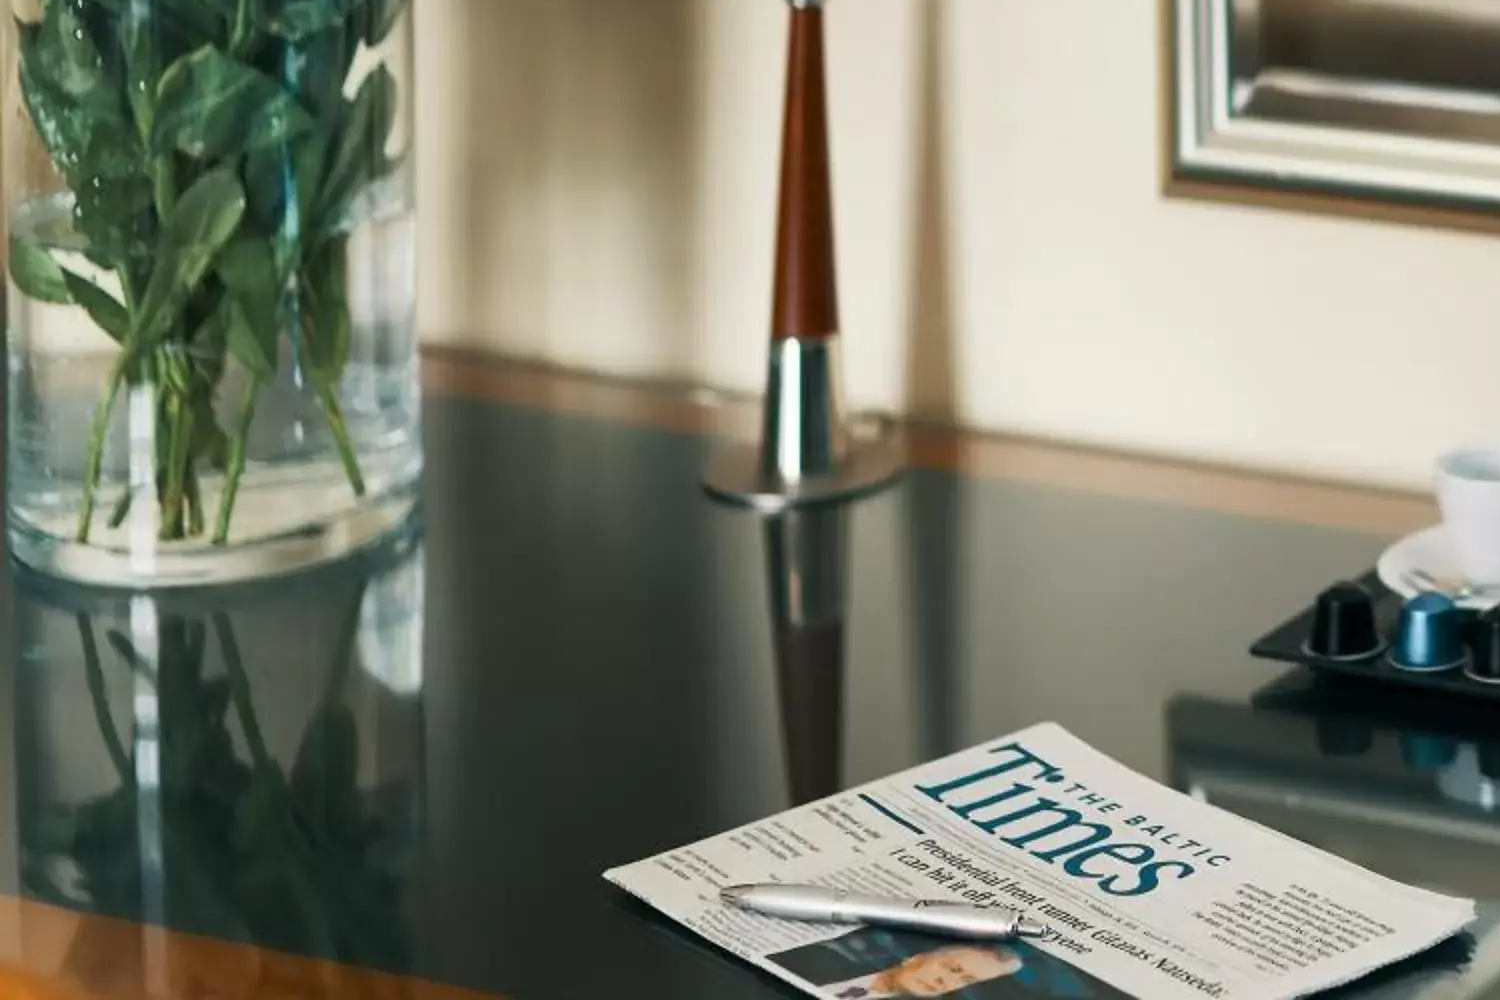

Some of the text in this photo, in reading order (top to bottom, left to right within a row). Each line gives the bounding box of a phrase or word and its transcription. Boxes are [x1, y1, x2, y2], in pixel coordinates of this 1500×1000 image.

[897, 855, 930, 871] can
[913, 741, 1196, 897] Times
[1063, 781, 1232, 868] THE BALTIC
[915, 839, 1011, 887] Presidential
[998, 881, 1047, 906] front
[1037, 903, 1096, 932] runner
